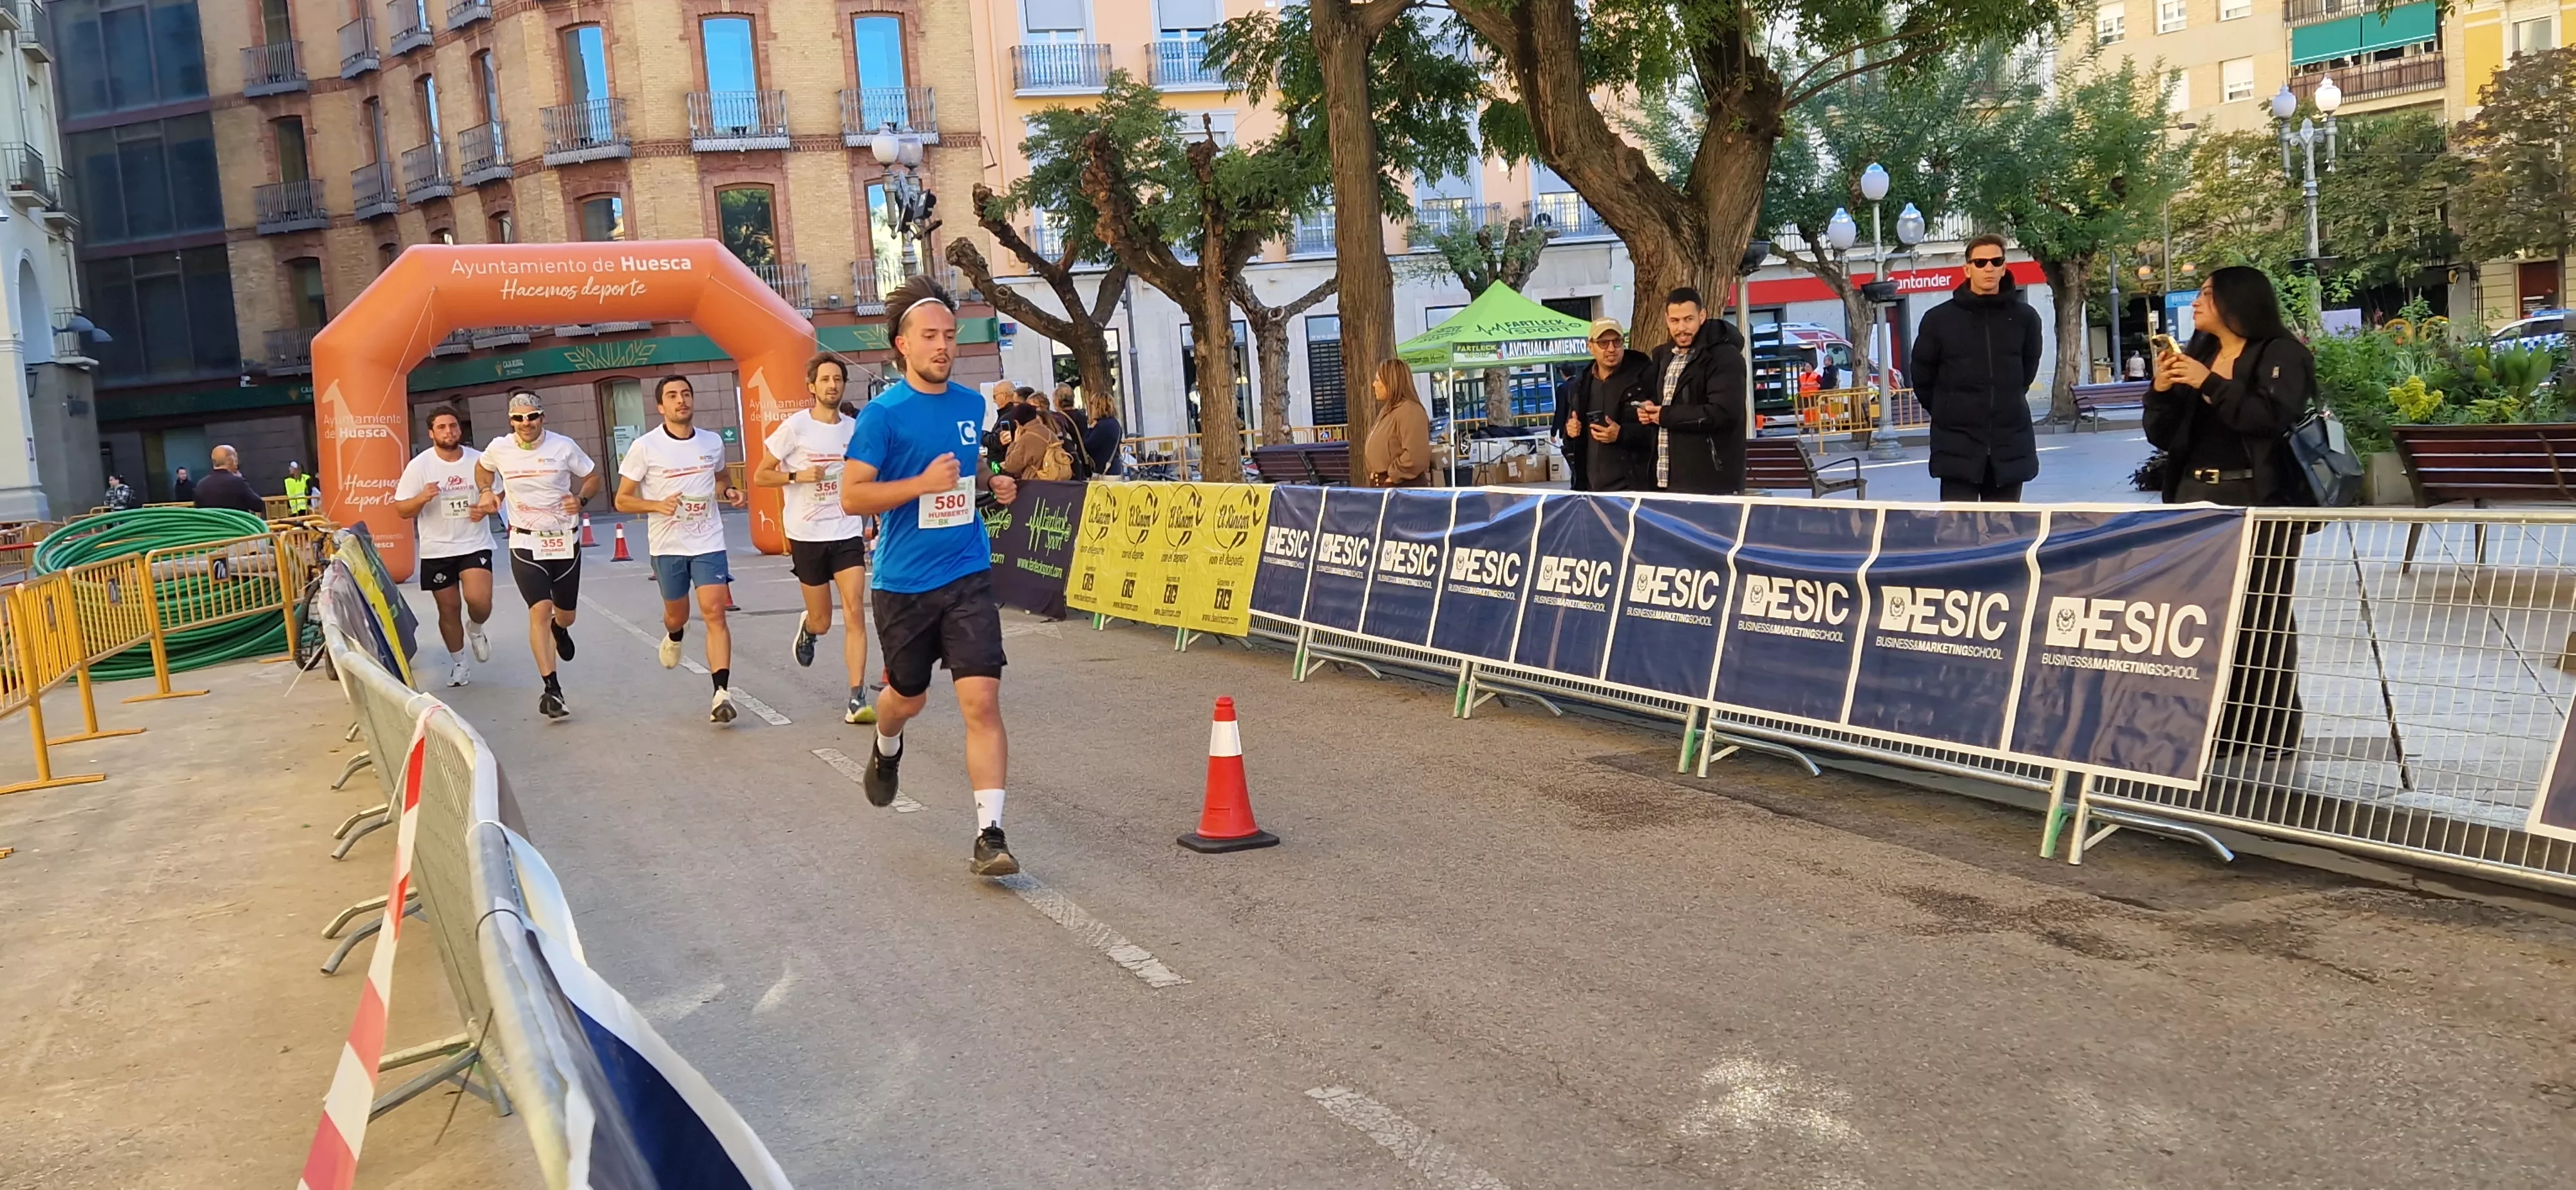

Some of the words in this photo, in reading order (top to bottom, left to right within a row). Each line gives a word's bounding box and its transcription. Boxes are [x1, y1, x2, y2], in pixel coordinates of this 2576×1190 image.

[451, 258, 587, 279] Ayuntamiento
[593, 257, 614, 272] de
[621, 256, 692, 271] Huesca
[500, 279, 578, 299] Hacemos
[581, 276, 647, 304] deporte
[1504, 319, 1565, 328] FARTLECK
[1509, 339, 1587, 357] AVITUALLAMIENTO
[324, 414, 401, 428] Ayuntamiento
[750, 411, 761, 421] de
[325, 429, 336, 439] de
[339, 428, 387, 438] Huesca
[815, 482, 837, 491] 356
[345, 490, 395, 512] deporte
[449, 500, 469, 509] 115
[685, 503, 706, 512] 354
[934, 494, 965, 510] 580
[928, 509, 969, 518] HUMBERTO
[1168, 505, 1176, 529] El
[1176, 505, 1193, 529] Rincón
[1217, 504, 1227, 529] El
[1228, 504, 1250, 529] Rincón
[541, 538, 564, 547] 355
[1276, 527, 1309, 558] ESIC
[1331, 534, 1369, 567] ESIC
[1392, 542, 1437, 577] ESIC
[1466, 548, 1521, 587] ESIC
[1555, 557, 1612, 598] ESIC
[1653, 567, 1719, 610] ESIC
[1768, 578, 1849, 625] ESIC
[1626, 605, 1713, 627] BUSINESS&MARKETINGSCHOOL
[1911, 588, 2009, 641] ESIC
[1738, 620, 1845, 642] BUSINESS&MARKETINGSCHOOL
[2084, 598, 2207, 658] ESIC
[1875, 636, 2003, 660] BUSINESS&MARKETINGSCHOOL
[2041, 652, 2200, 681] BUSINESS&MARKETINGSCHOOL
